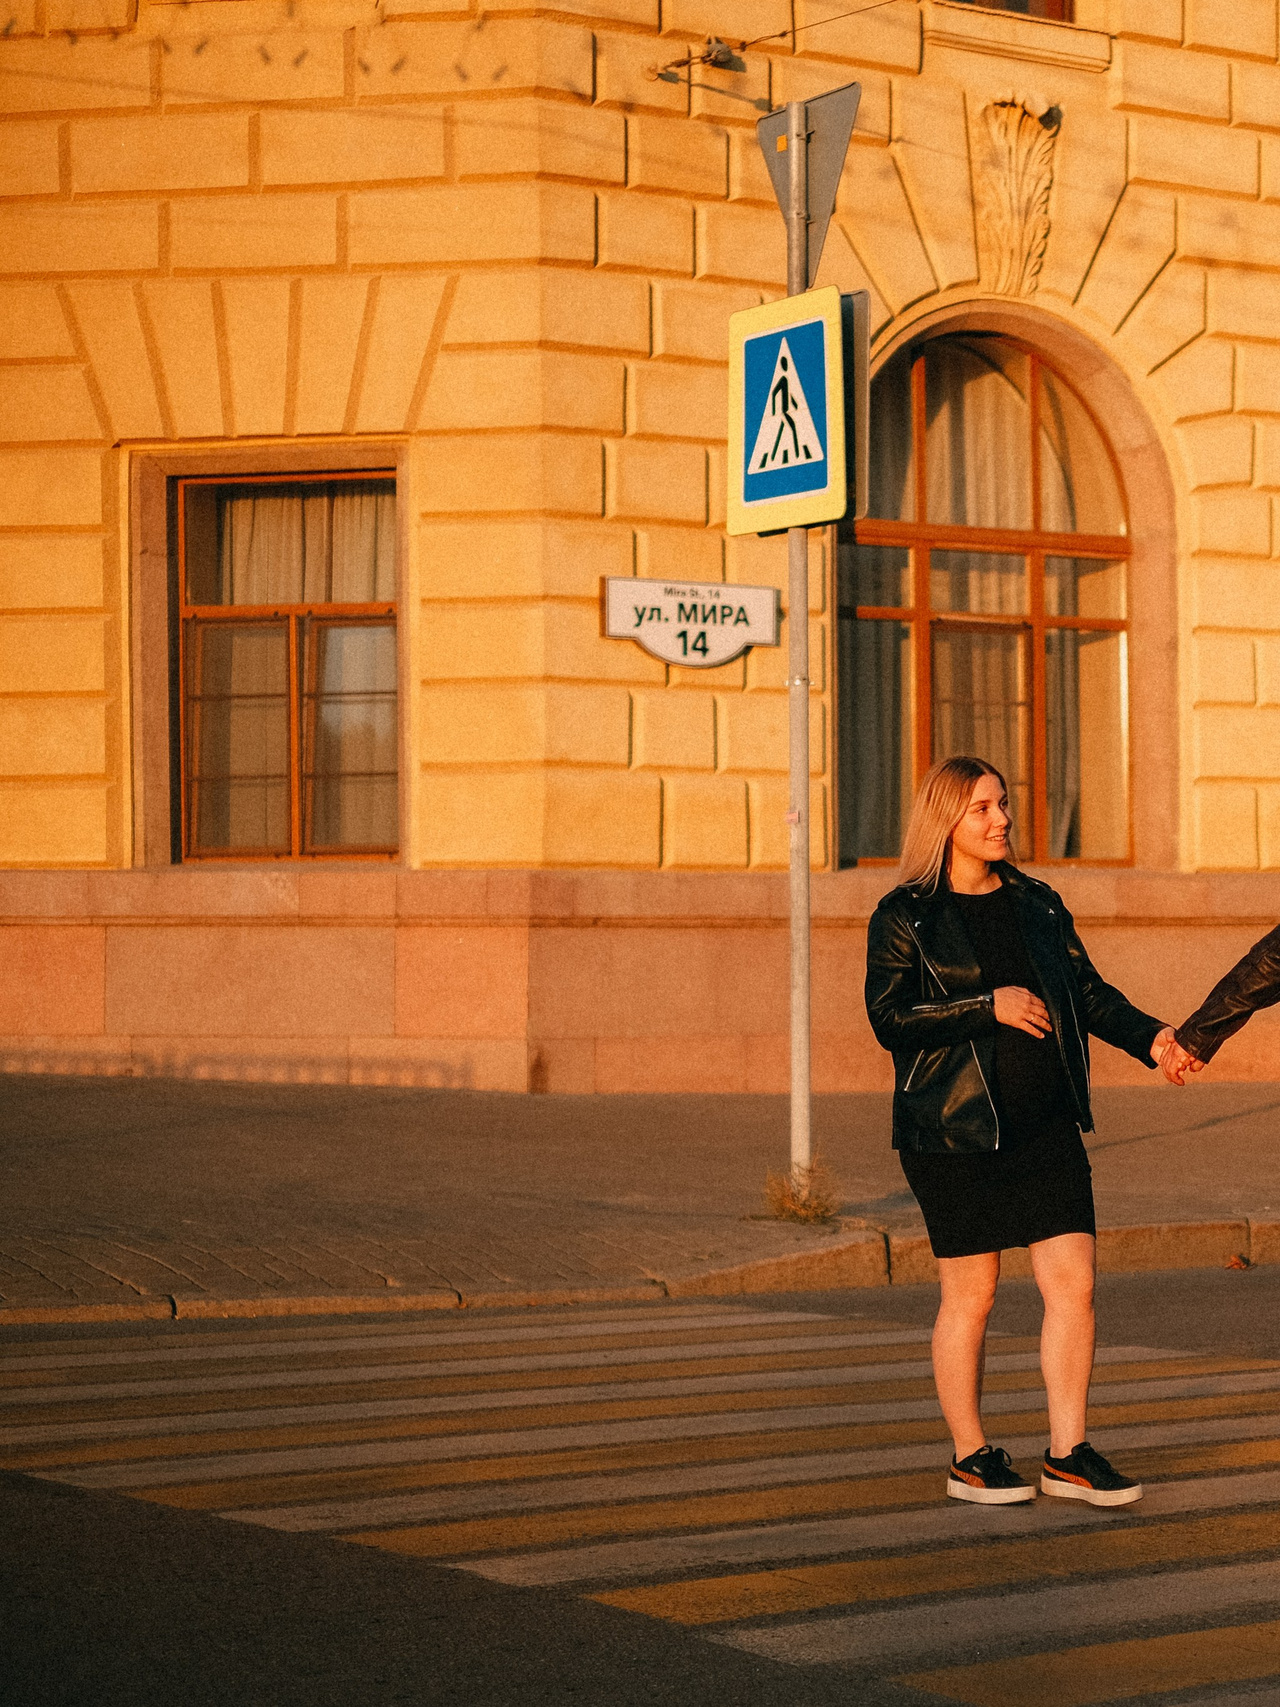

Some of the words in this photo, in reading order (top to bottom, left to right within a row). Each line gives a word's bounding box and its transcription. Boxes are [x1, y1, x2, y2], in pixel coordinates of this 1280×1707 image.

[707, 589, 721, 599] 14
[634, 606, 669, 627] ул.
[677, 602, 750, 627] МИРА
[676, 630, 710, 657] 14
